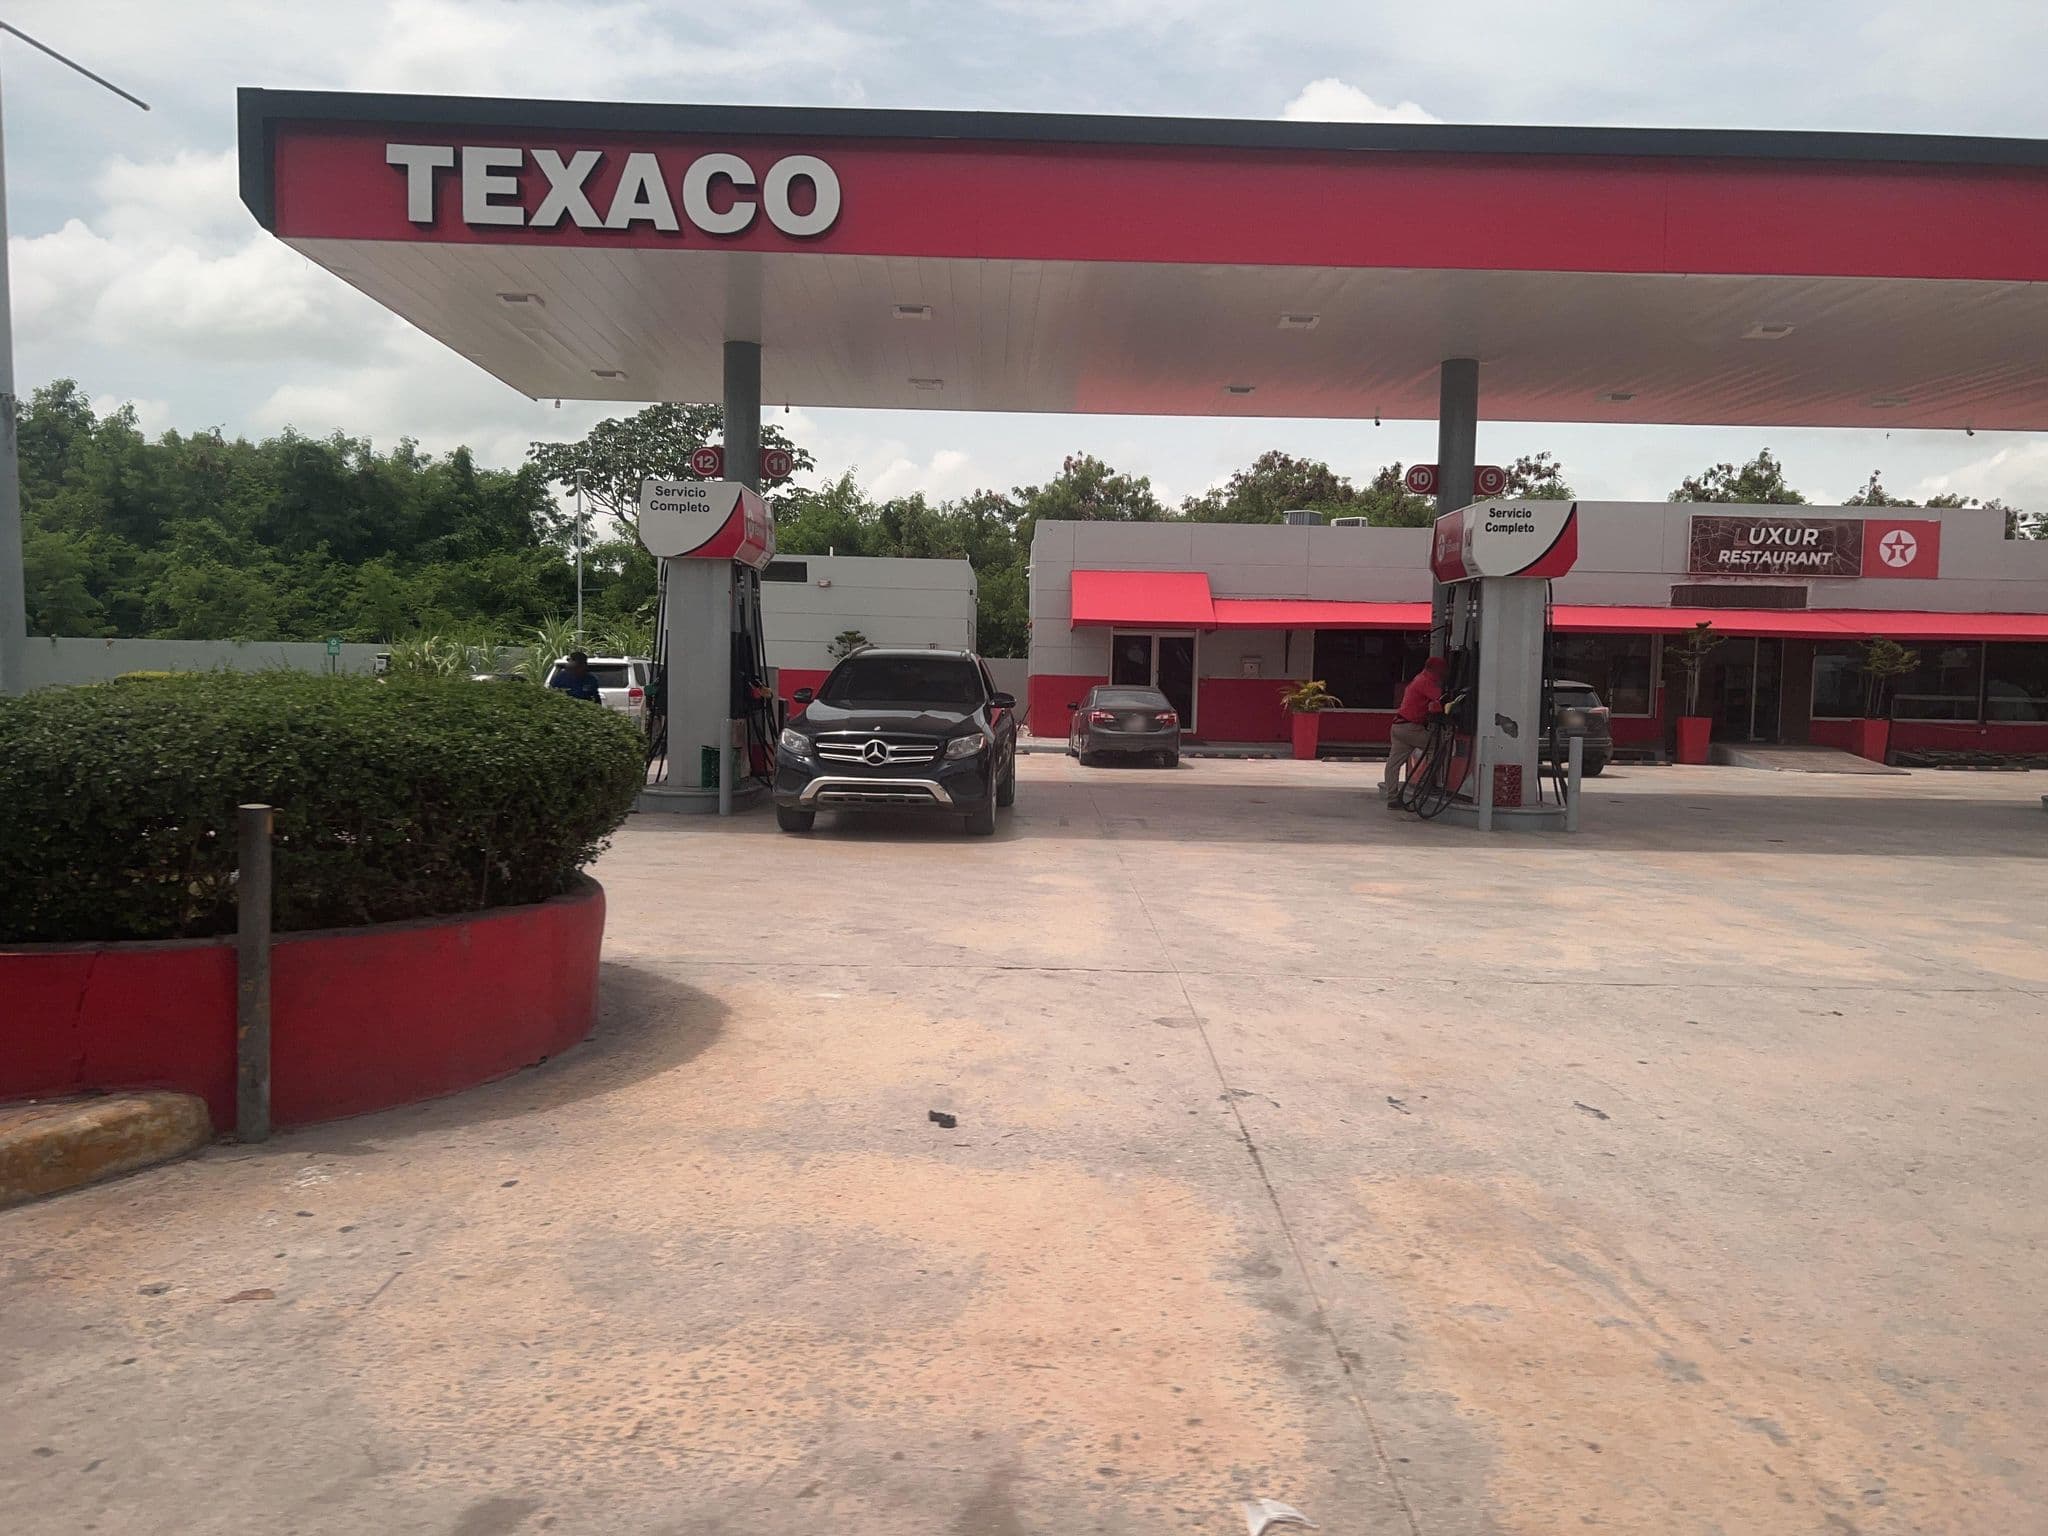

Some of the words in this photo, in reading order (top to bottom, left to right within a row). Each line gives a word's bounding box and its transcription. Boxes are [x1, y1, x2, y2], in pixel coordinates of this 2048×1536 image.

[386, 143, 841, 236] TEXACO
[697, 455, 714, 469] 12
[770, 457, 787, 471] 11
[1411, 472, 1428, 486] 10
[1486, 473, 1497, 486] 9
[655, 485, 707, 498] Servicio
[650, 500, 710, 514] Completo
[1489, 507, 1532, 519] Servicio
[1485, 522, 1535, 535] Completo
[1718, 549, 1833, 566] RESTAURANT
